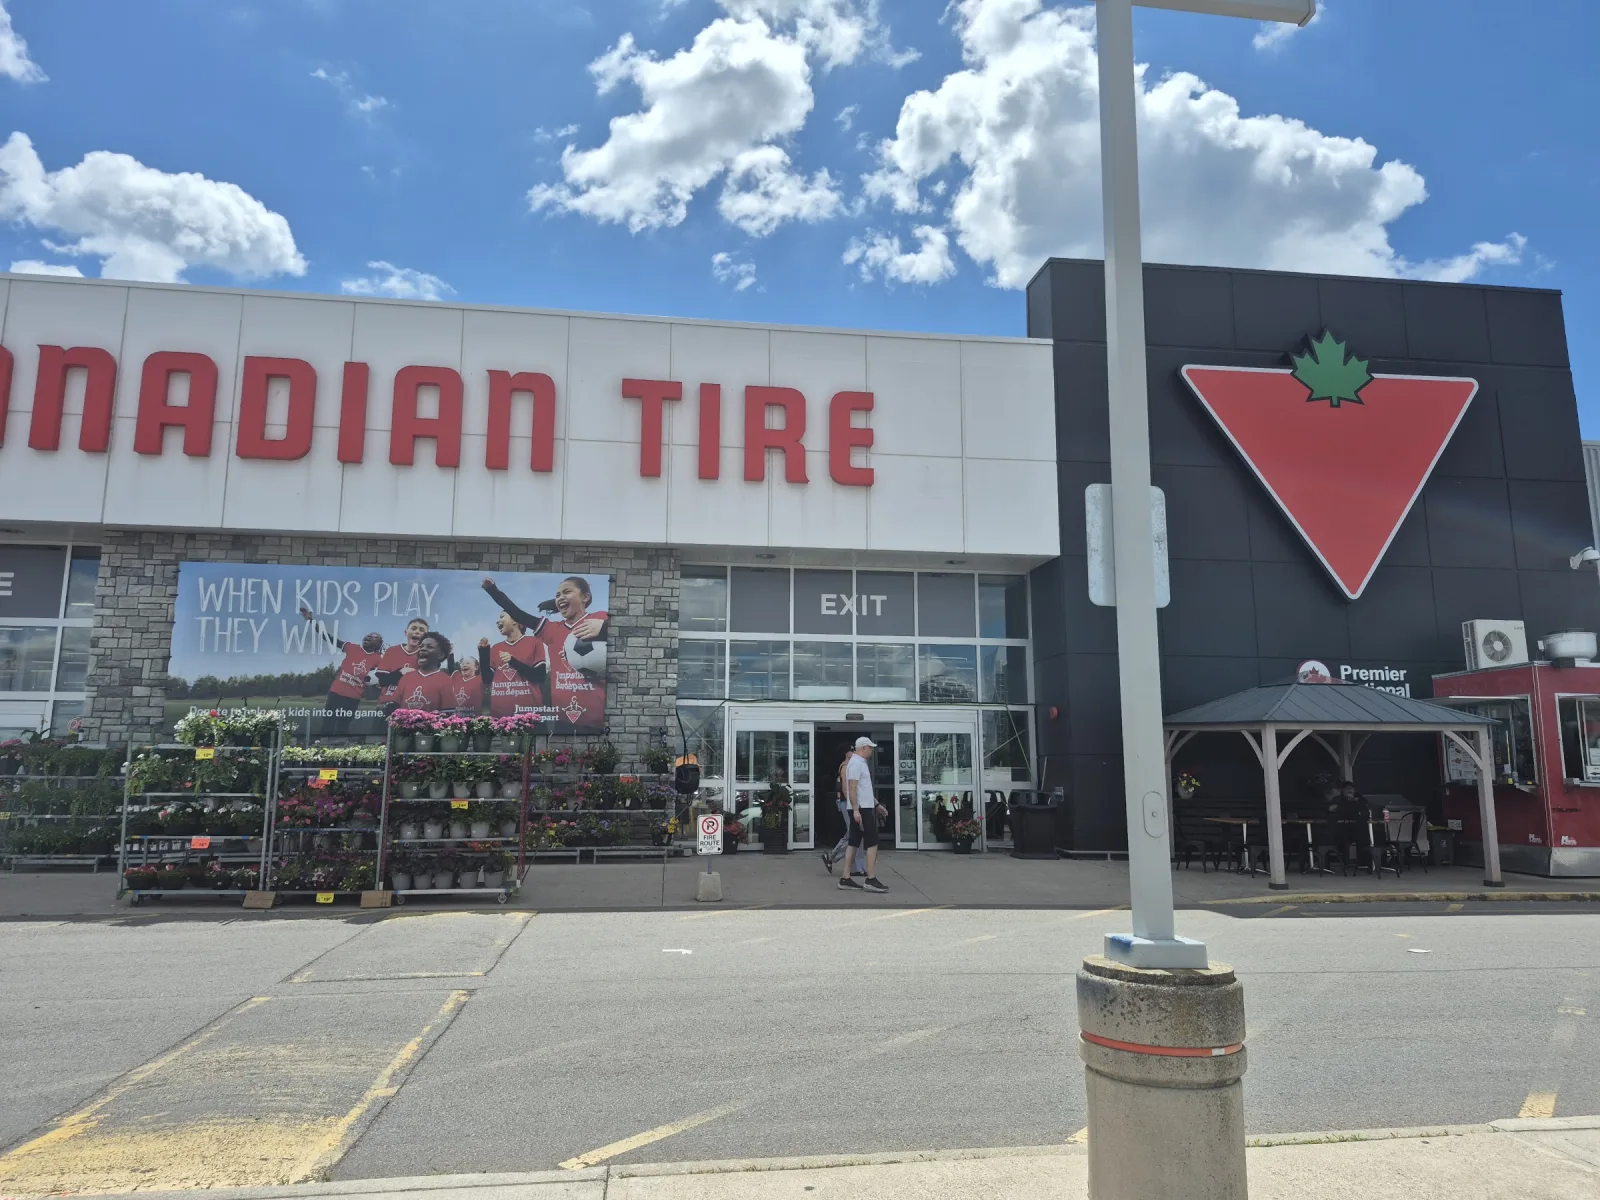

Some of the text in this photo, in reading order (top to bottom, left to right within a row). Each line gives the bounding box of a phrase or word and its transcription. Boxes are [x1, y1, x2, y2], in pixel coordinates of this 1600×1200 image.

[0, 344, 875, 487] NADIAN TIRE
[198, 577, 440, 624] WHEN KIDS PLAY,
[821, 593, 888, 616] EXIT
[195, 616, 269, 653] THEY
[1340, 665, 1407, 681] Premier
[491, 680, 529, 688] Jumpstart
[505, 687, 531, 696] départ
[288, 706, 310, 717] kids
[312, 707, 333, 717] into
[335, 708, 352, 718] the
[354, 709, 386, 720] game.
[514, 704, 560, 713] Jumpstart
